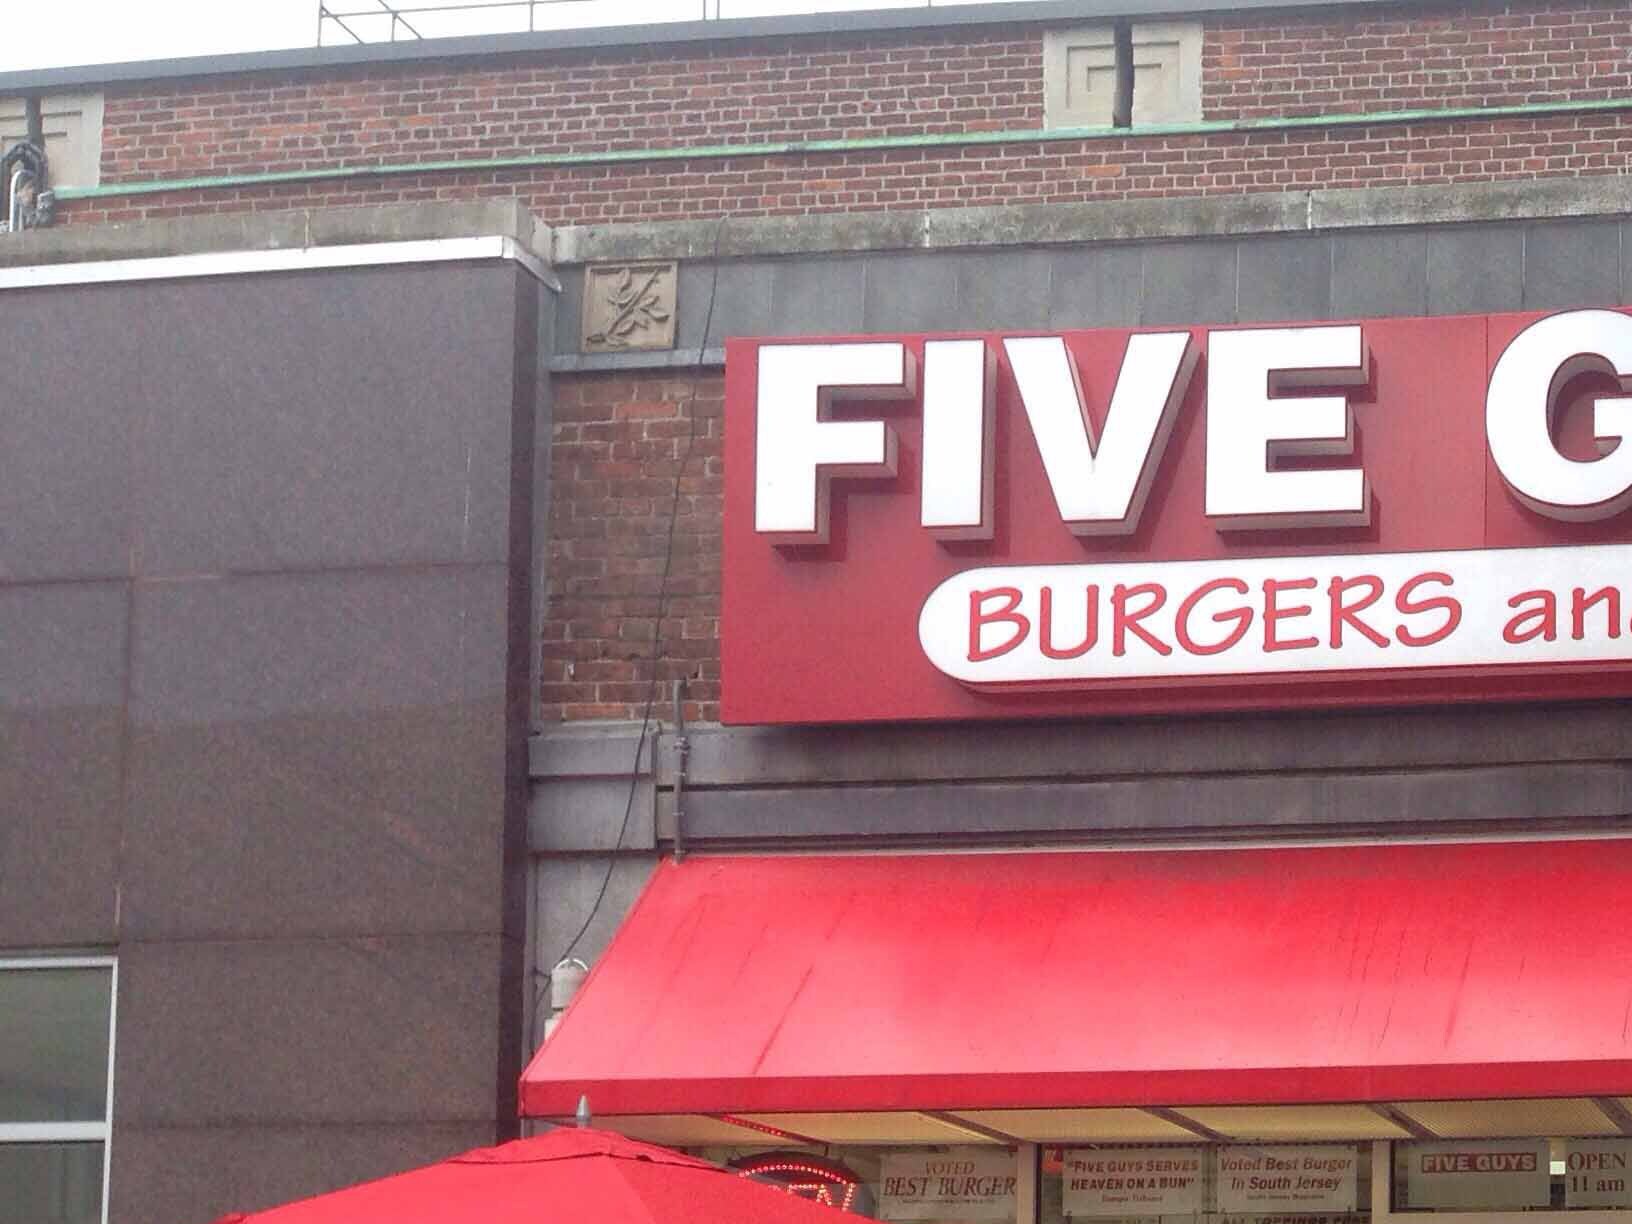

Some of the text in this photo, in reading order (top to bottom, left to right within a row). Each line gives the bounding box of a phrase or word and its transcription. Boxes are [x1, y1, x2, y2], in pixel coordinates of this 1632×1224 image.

[754, 325, 1370, 538] FIVE
[966, 571, 1463, 662] BURGERS
[926, 1161, 976, 1175] VOTED
[1107, 1160, 1143, 1173] GUYS
[1145, 1159, 1199, 1173] SERVES
[1220, 1157, 1353, 1173] Voted Best Burger
[1423, 1154, 1535, 1171] FIVE GUYS
[1567, 1151, 1627, 1170] OPEN
[883, 1176, 1017, 1196] BEST BURGER
[1071, 1178, 1123, 1190] HEAVEN
[1126, 1178, 1145, 1189] ON
[1146, 1178, 1156, 1189] A
[1249, 1176, 1291, 1190] South
[1295, 1176, 1343, 1191] Jersey
[1572, 1175, 1588, 1192] 11
[1596, 1178, 1625, 1192] am
